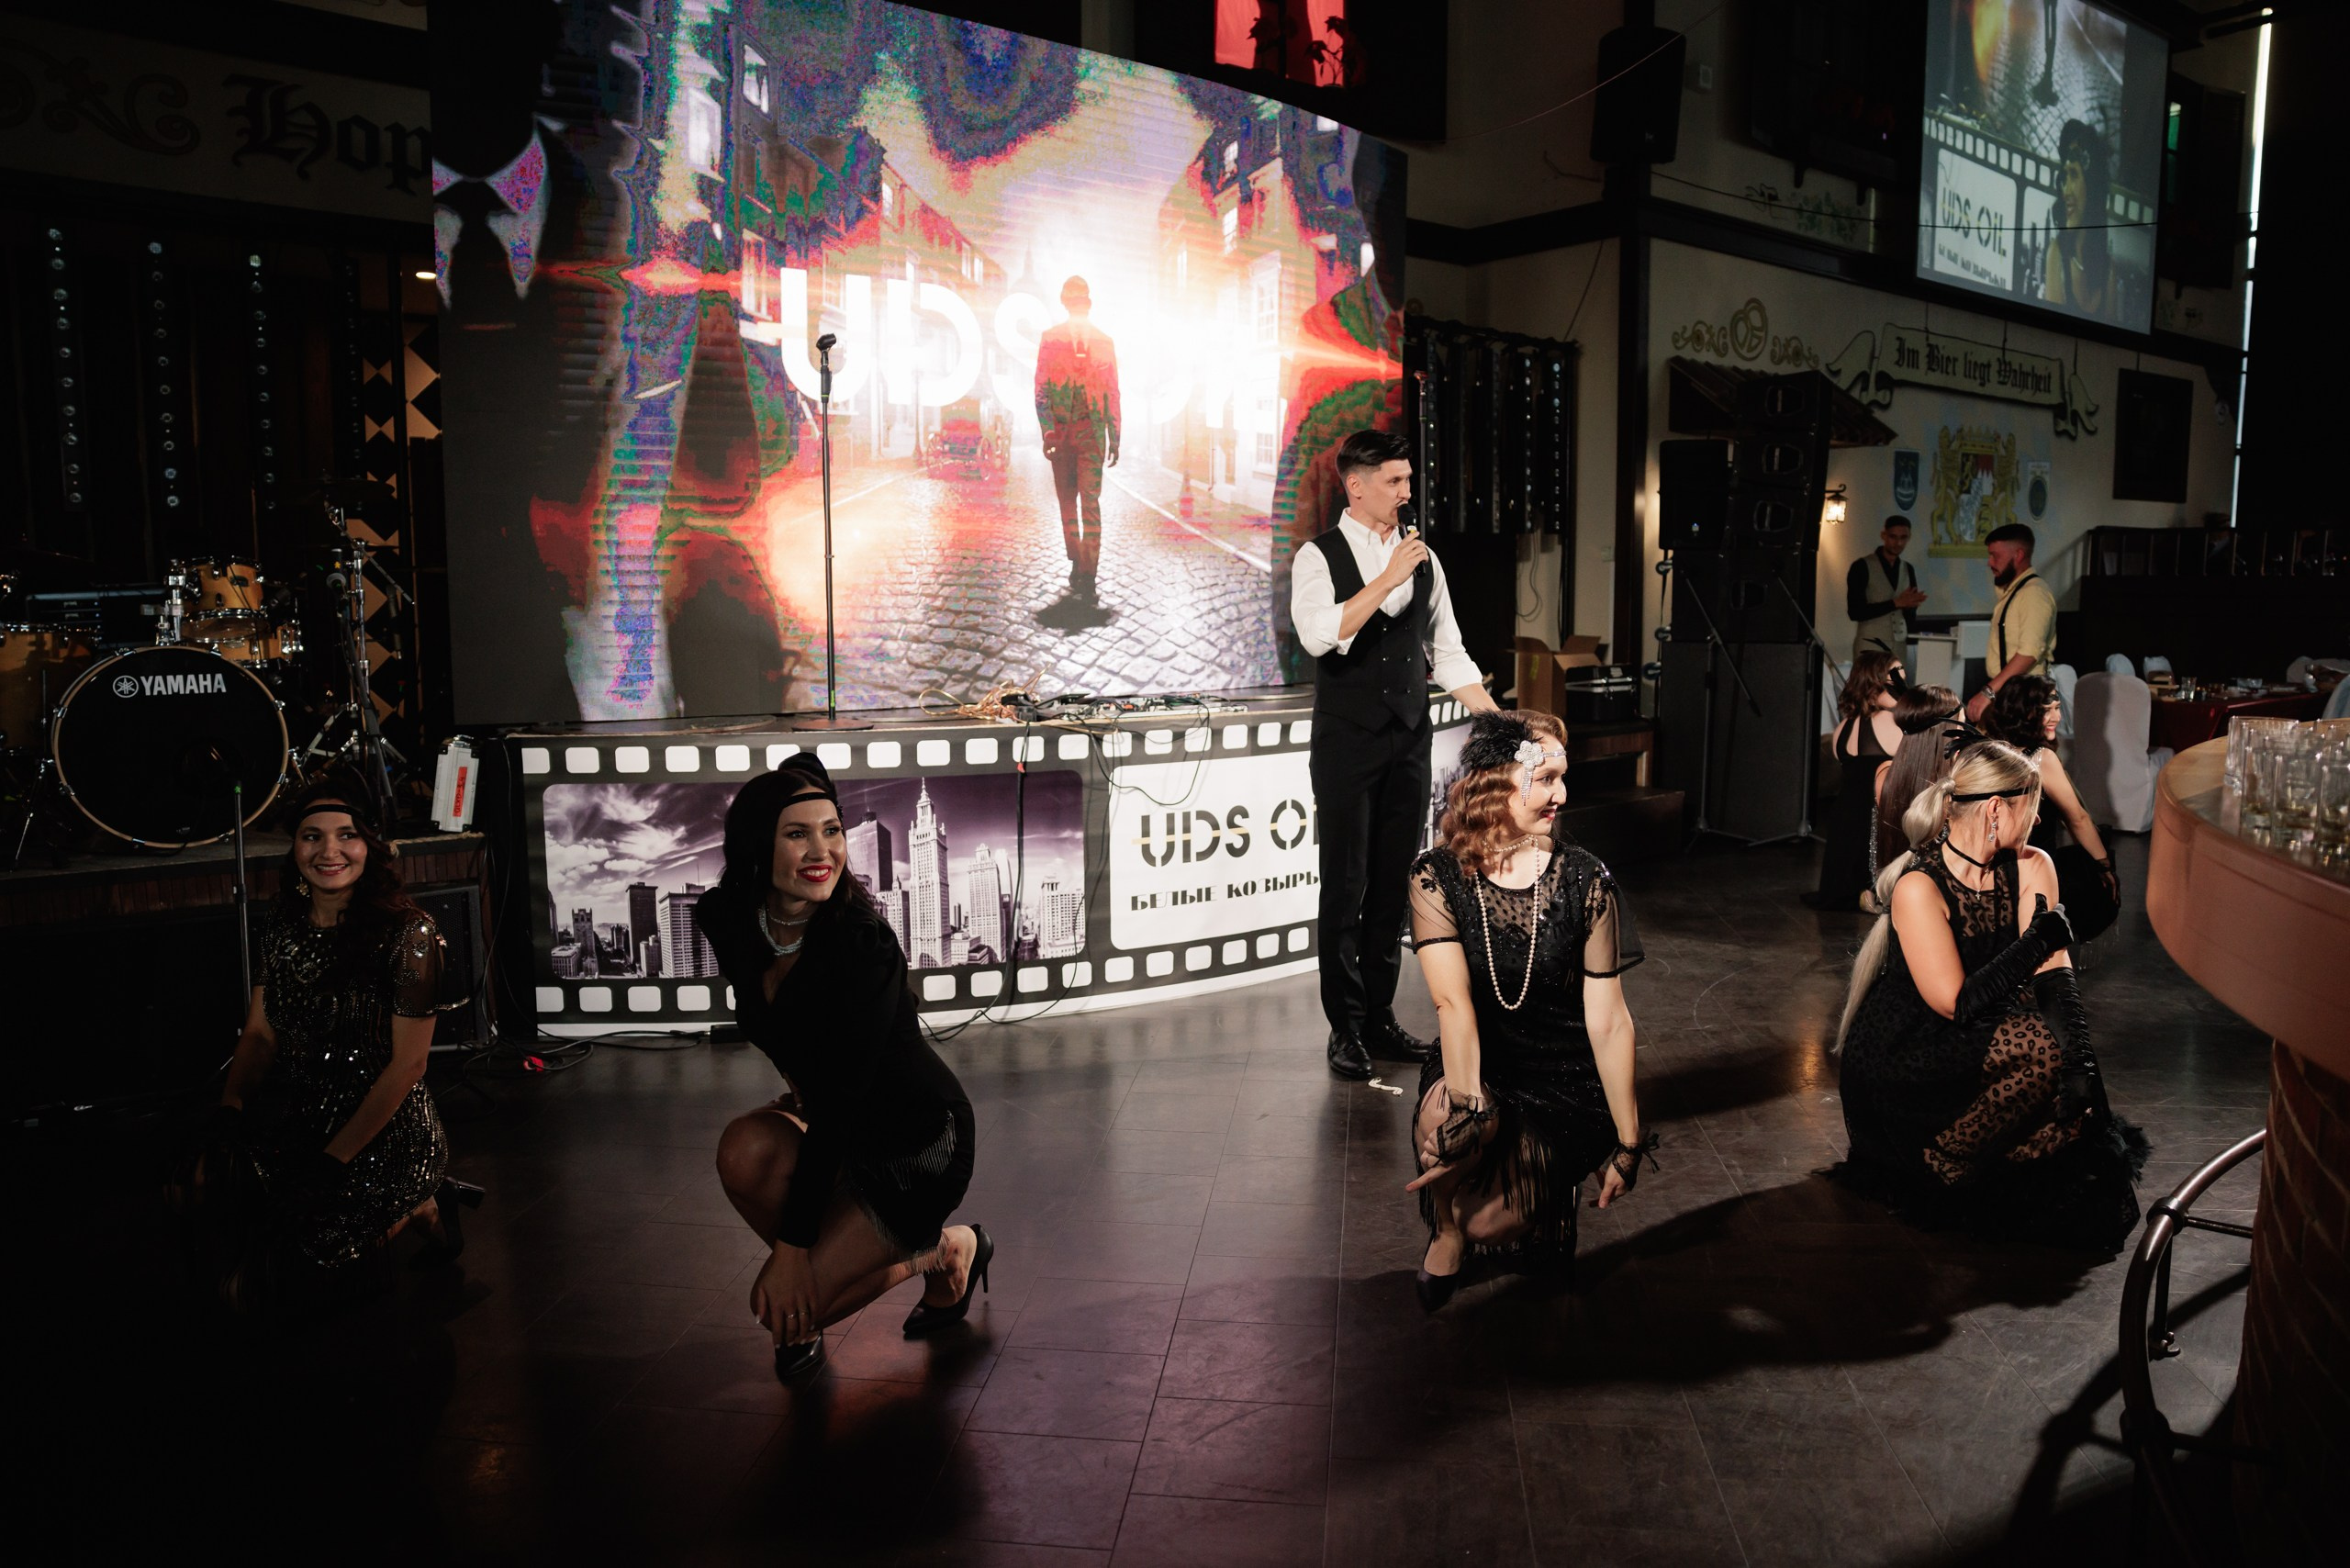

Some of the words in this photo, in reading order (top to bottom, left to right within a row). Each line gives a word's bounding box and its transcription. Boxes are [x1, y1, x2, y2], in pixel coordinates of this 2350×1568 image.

[1942, 186, 1972, 239] UDS
[1977, 206, 2008, 258] OIL
[1894, 336, 1920, 370] Im
[1926, 342, 1959, 377] Bier
[1964, 352, 1992, 386] liegt
[1998, 357, 2053, 398] Wahrheit
[140, 673, 227, 696] YAMAHA
[1140, 805, 1251, 868] UDS
[1131, 885, 1219, 911] БЕЛЫЕ
